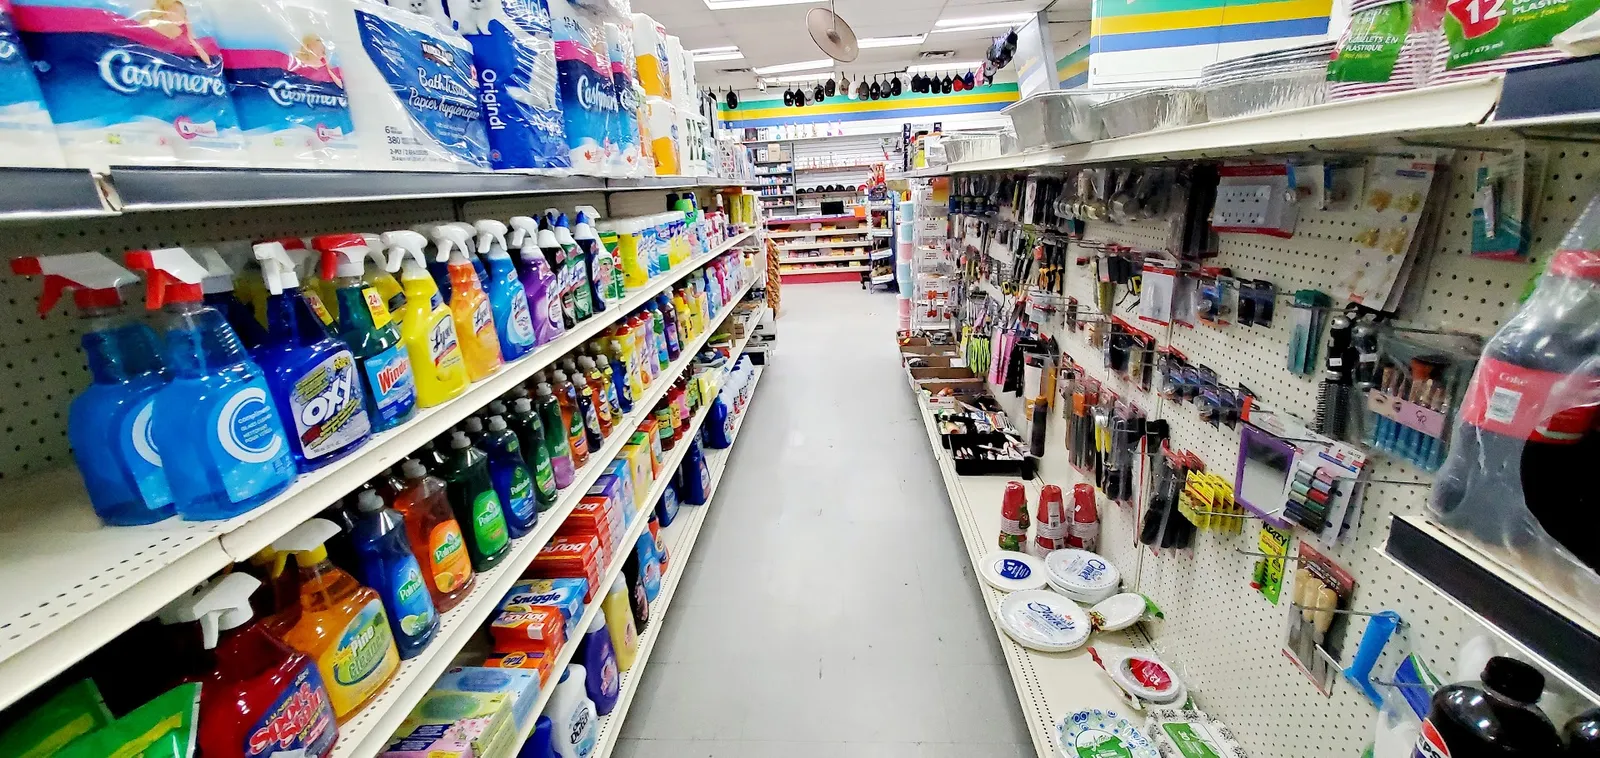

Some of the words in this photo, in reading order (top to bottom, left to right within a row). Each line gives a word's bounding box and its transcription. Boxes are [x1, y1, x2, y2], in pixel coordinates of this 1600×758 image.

[1465, 0, 1507, 24] 12
[1385, 36, 1399, 44] EN
[99, 49, 227, 97] Cashmere
[416, 66, 445, 91] Bath
[408, 86, 438, 113] Papier
[481, 68, 507, 130] Original
[387, 135, 401, 145] 380
[1499, 372, 1529, 386] Coke
[302, 363, 353, 426] OXY
[508, 592, 561, 606] Snuggle
[351, 624, 374, 658] Pine
